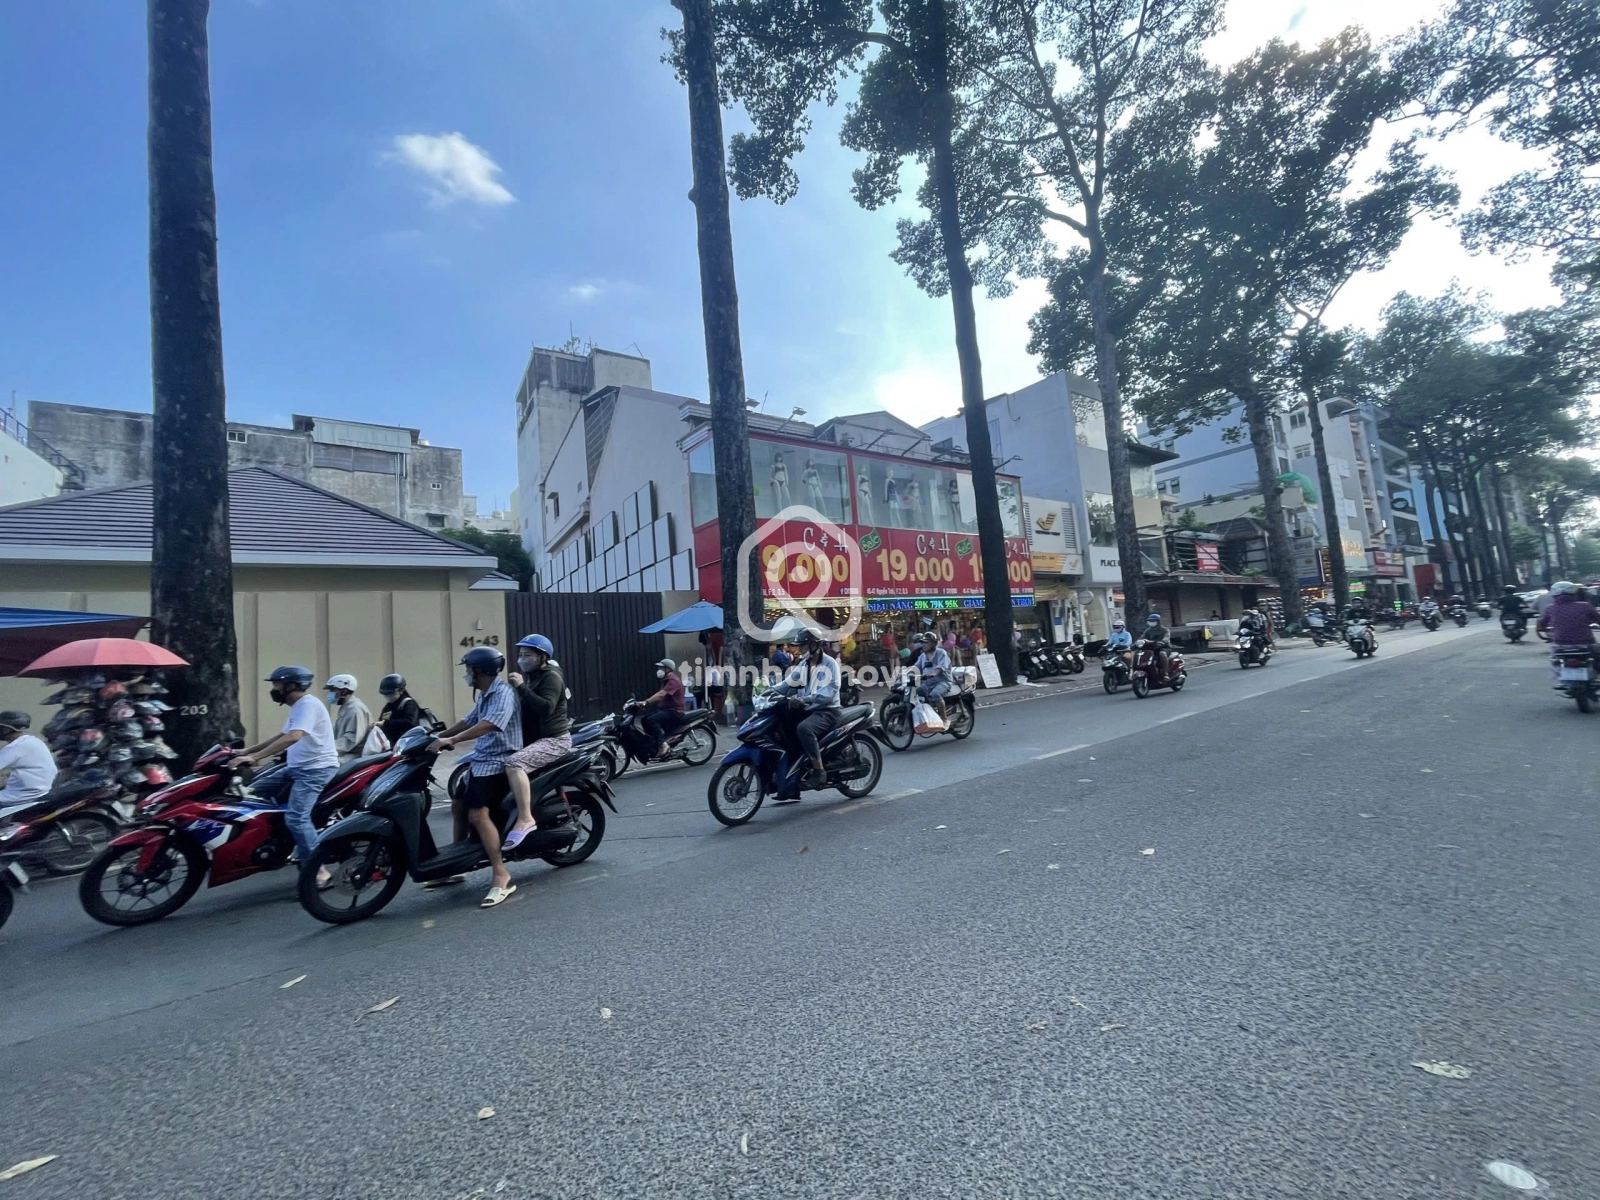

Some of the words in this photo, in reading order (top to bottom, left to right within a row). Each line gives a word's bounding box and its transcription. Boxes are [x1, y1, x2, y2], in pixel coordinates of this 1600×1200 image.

[803, 527, 816, 551] C
[820, 533, 828, 547] &
[833, 527, 849, 553] H
[861, 535, 880, 553] Sale
[916, 534, 927, 555] C
[928, 537, 935, 549] &
[938, 533, 950, 556] H
[1012, 542, 1018, 553] &
[1020, 539, 1030, 559] H
[876, 548, 954, 582] 19.000
[914, 600, 929, 609] 59K
[930, 600, 944, 609] 79K
[944, 600, 959, 608] 95K
[460, 635, 499, 648] 41-43
[180, 704, 208, 716] 203
